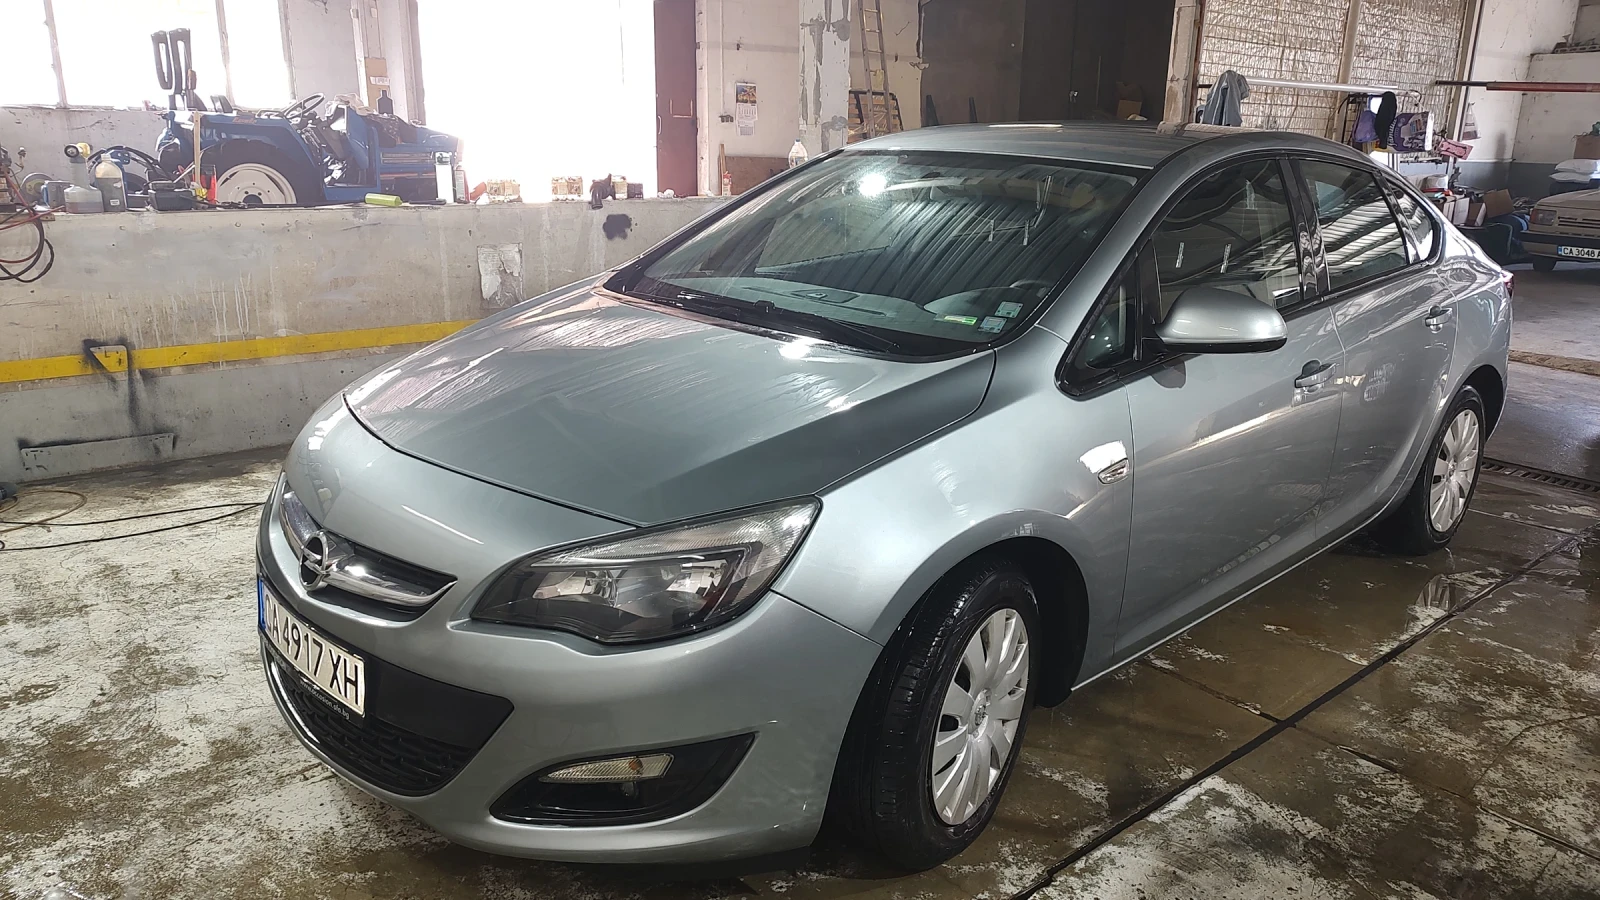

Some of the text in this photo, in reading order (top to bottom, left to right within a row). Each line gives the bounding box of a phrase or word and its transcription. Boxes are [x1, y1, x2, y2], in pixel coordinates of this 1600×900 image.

[1563, 247, 1574, 256] CA
[1575, 248, 1595, 258] 3048
[265, 593, 281, 644] CA
[283, 616, 326, 679] 4917
[329, 648, 361, 706] XH
